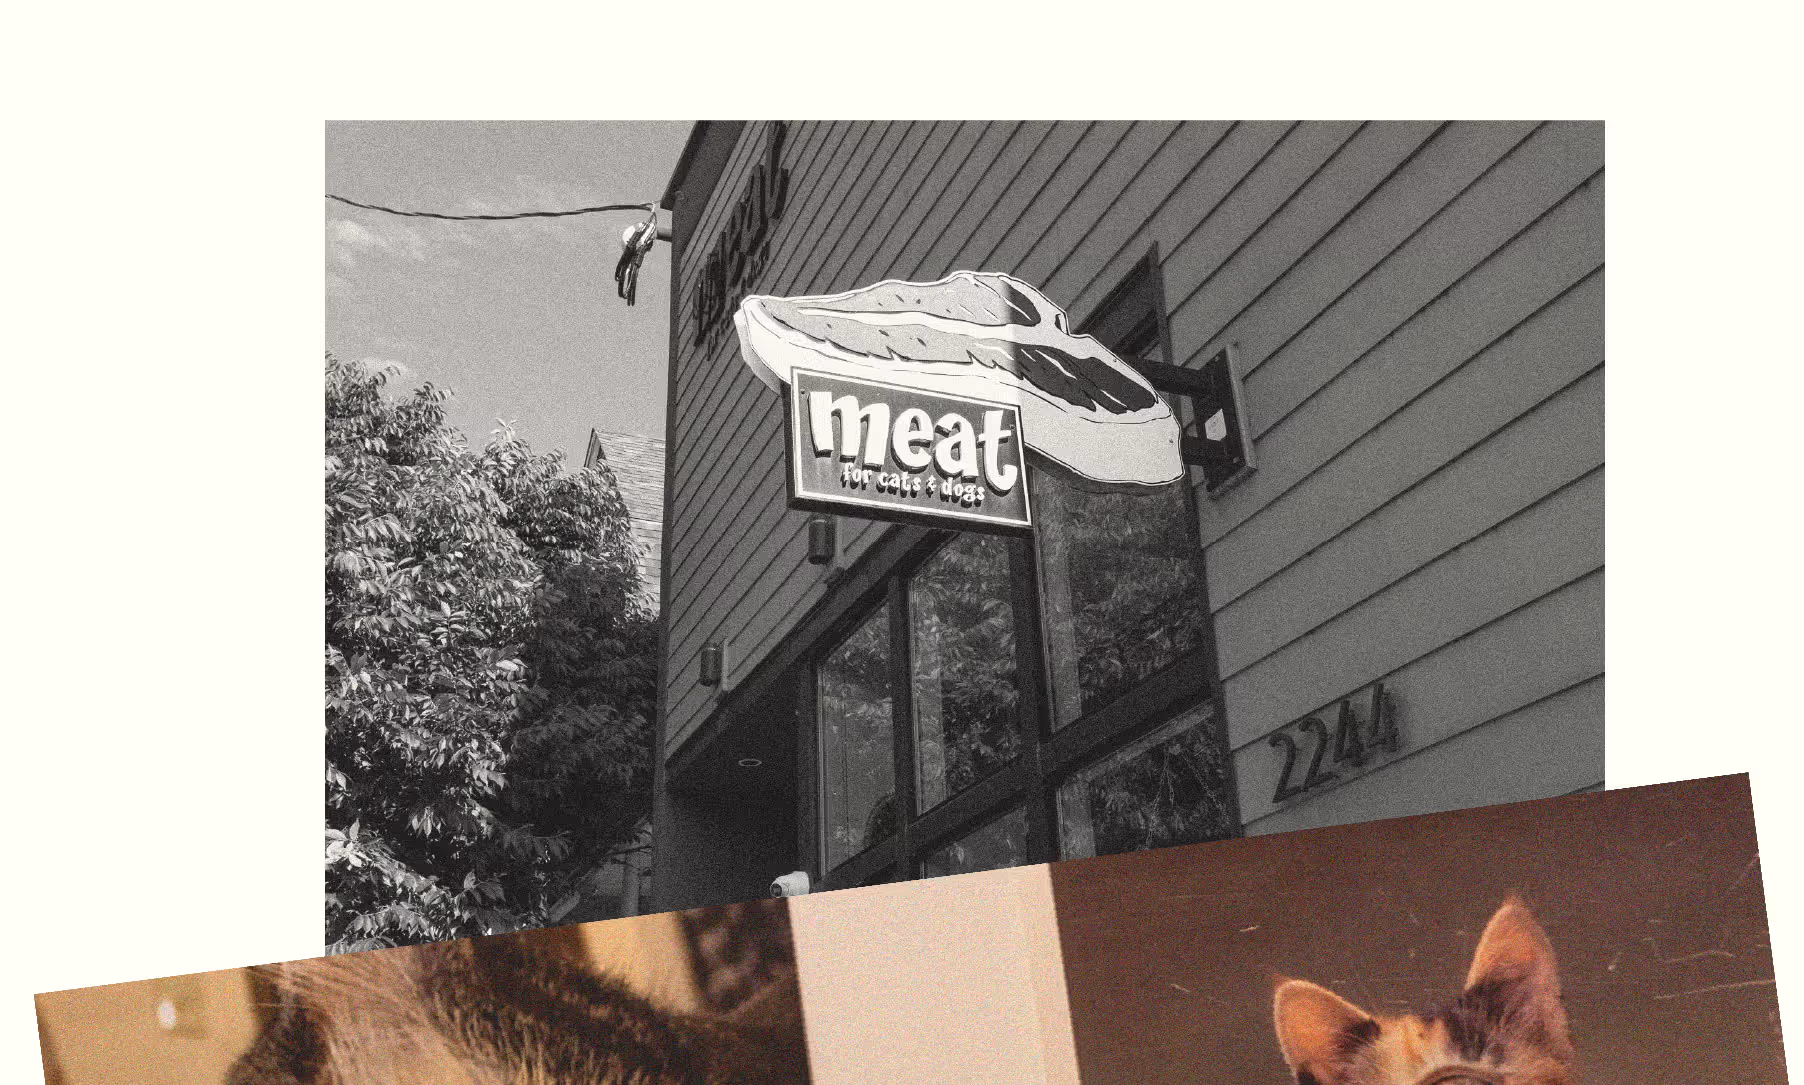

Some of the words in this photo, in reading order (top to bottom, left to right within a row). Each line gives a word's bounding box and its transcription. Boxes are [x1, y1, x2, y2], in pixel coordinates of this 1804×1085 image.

[808, 391, 1018, 495] meat
[841, 462, 873, 486] for
[878, 469, 920, 493] cats
[925, 475, 937, 492] &
[940, 477, 985, 503] dogs
[1268, 683, 1400, 804] 2244
